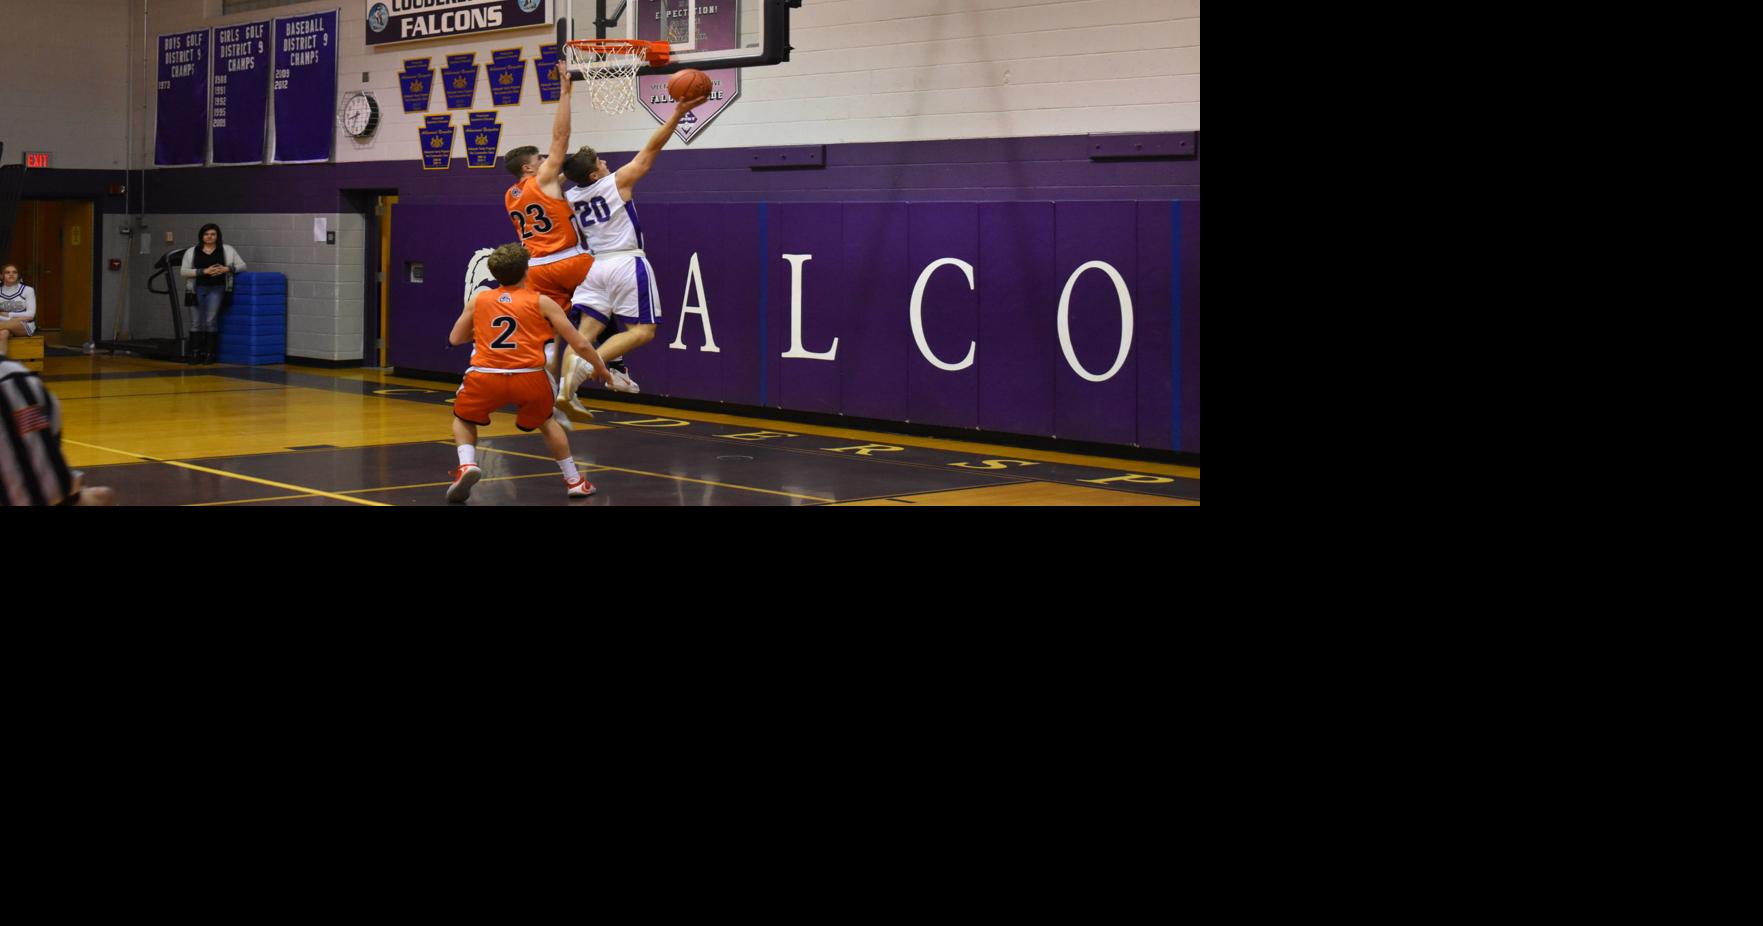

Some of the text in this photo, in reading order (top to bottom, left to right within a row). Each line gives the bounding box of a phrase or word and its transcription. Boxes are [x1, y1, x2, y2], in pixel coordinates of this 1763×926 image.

[655, 5, 718, 20] EPECTION!
[286, 18, 324, 36] BASEBALL
[401, 5, 503, 39] FALCONS
[165, 33, 202, 50] BOYS GOLF
[220, 25, 264, 43] GIRLS GOLF
[283, 33, 328, 52] DISTRICT 9
[165, 49, 194, 64] DISTRICT
[220, 42, 263, 58] DISTRICT 9
[290, 50, 319, 66] CHAMPS
[171, 63, 195, 78] CHAMPS
[228, 57, 255, 72] CHAMPS
[27, 154, 49, 168] EXIT
[574, 195, 611, 228] 20
[509, 203, 553, 240] 23
[490, 316, 518, 349] 2
